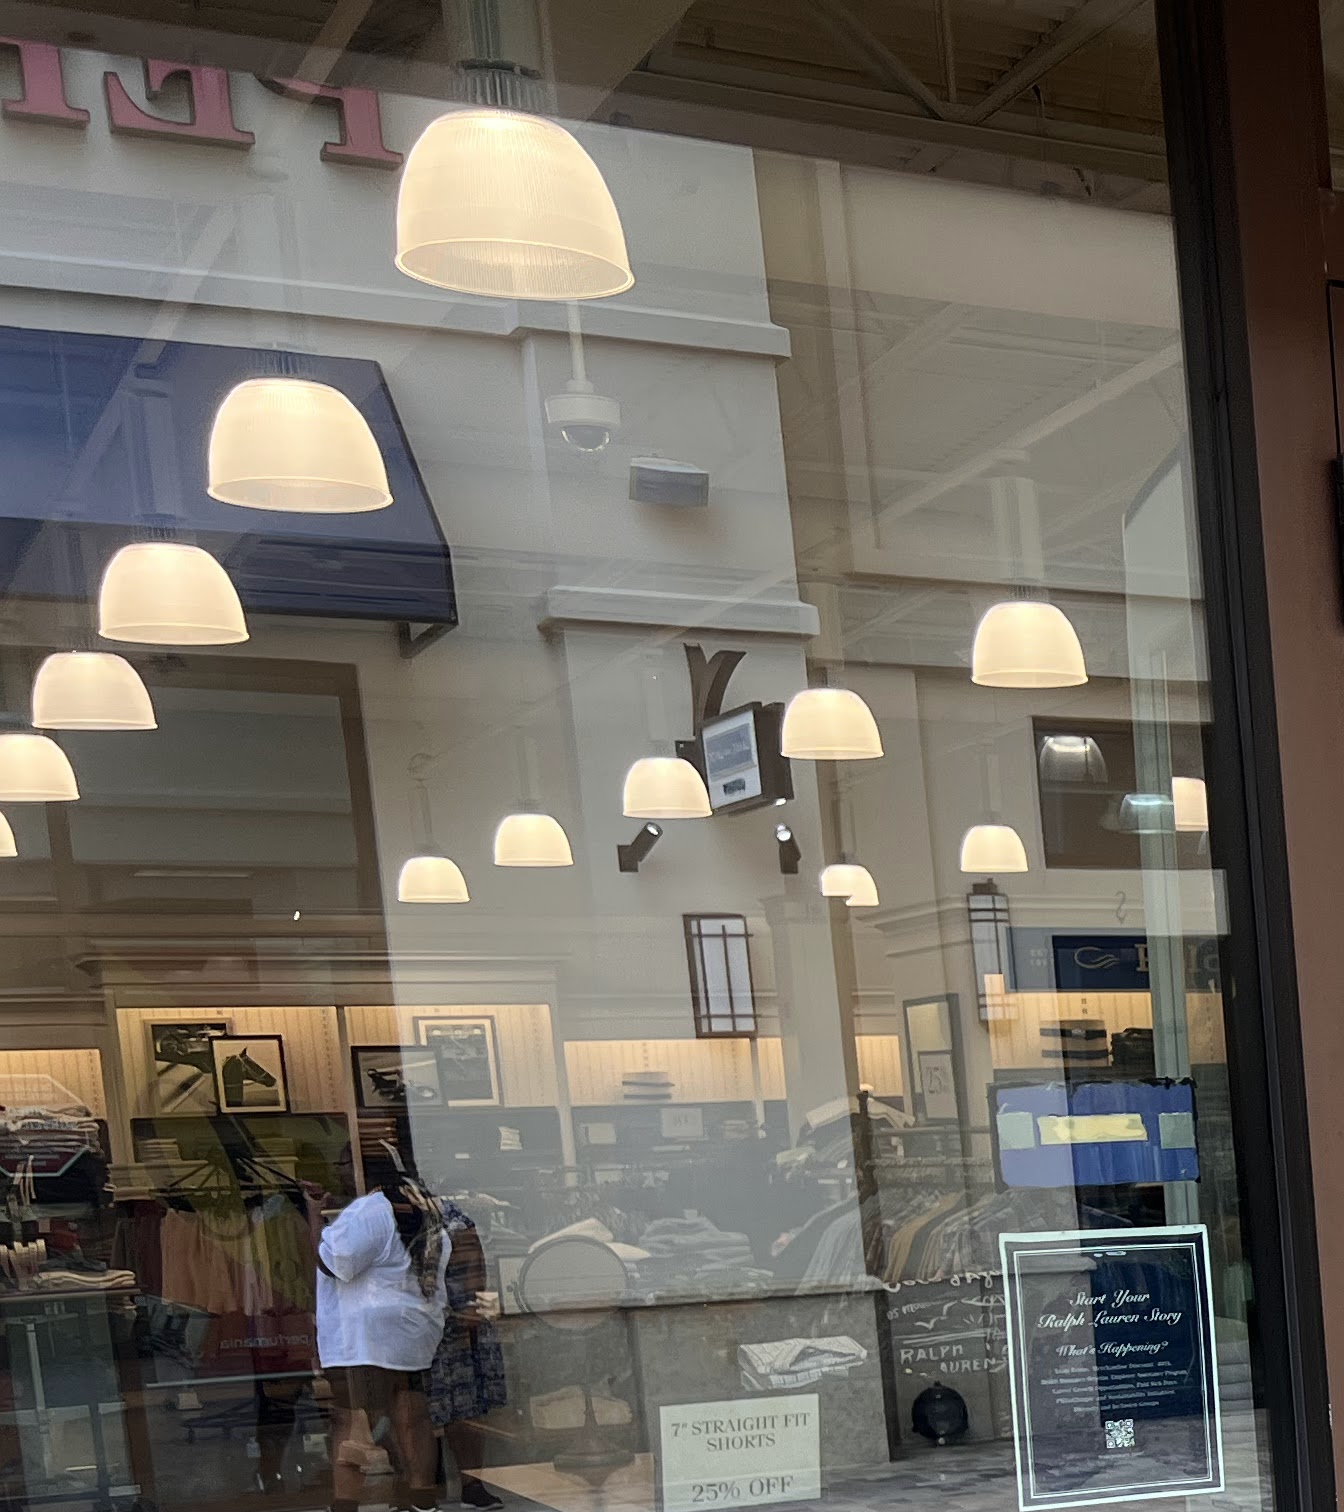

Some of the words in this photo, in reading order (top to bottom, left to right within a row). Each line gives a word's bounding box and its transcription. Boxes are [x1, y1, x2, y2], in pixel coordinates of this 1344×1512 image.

[1069, 1291, 1106, 1306] Start
[1111, 1289, 1150, 1308] Your
[1038, 1312, 1085, 1332] Ralph
[1088, 1312, 1140, 1328] Lauren
[1144, 1307, 1182, 1325] Story
[1056, 1344, 1096, 1357] What's
[1099, 1340, 1169, 1358] Happening?
[691, 1414, 778, 1436] STRAIGHT
[783, 1412, 811, 1428] FIT
[706, 1433, 776, 1452] SHORTS
[692, 1480, 741, 1503] 25%
[749, 1475, 794, 1497] OFF
